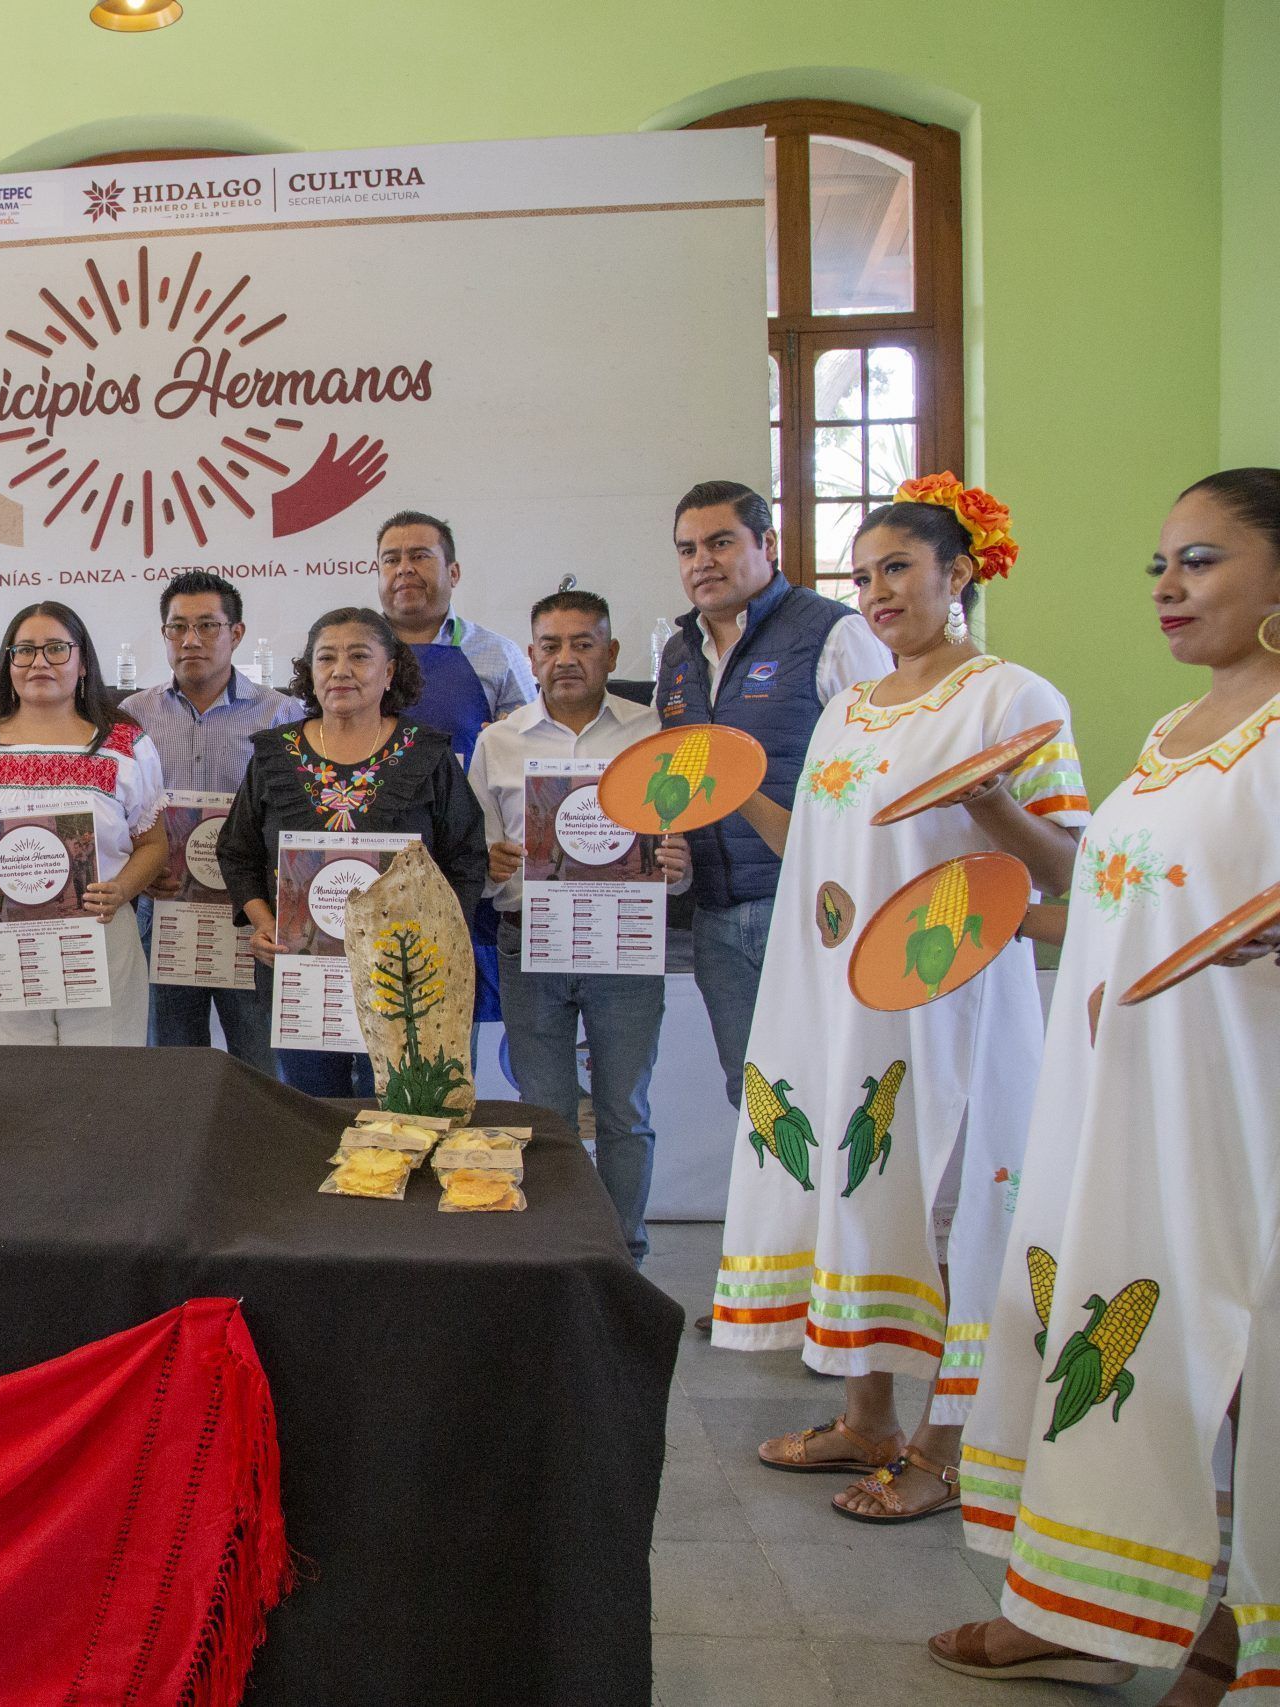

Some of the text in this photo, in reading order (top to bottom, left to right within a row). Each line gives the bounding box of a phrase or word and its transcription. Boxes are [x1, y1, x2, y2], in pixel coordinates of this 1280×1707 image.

[132, 178, 261, 204] HIDALGO
[288, 167, 425, 192] CULTURA
[132, 199, 262, 214] PRIMERO EL PUEBLO
[288, 191, 420, 206] SECRETARÍA DE CULTURA
[154, 346, 433, 419] Hermanos
[59, 569, 125, 584] DANZA
[306, 558, 379, 576] MÚSICA
